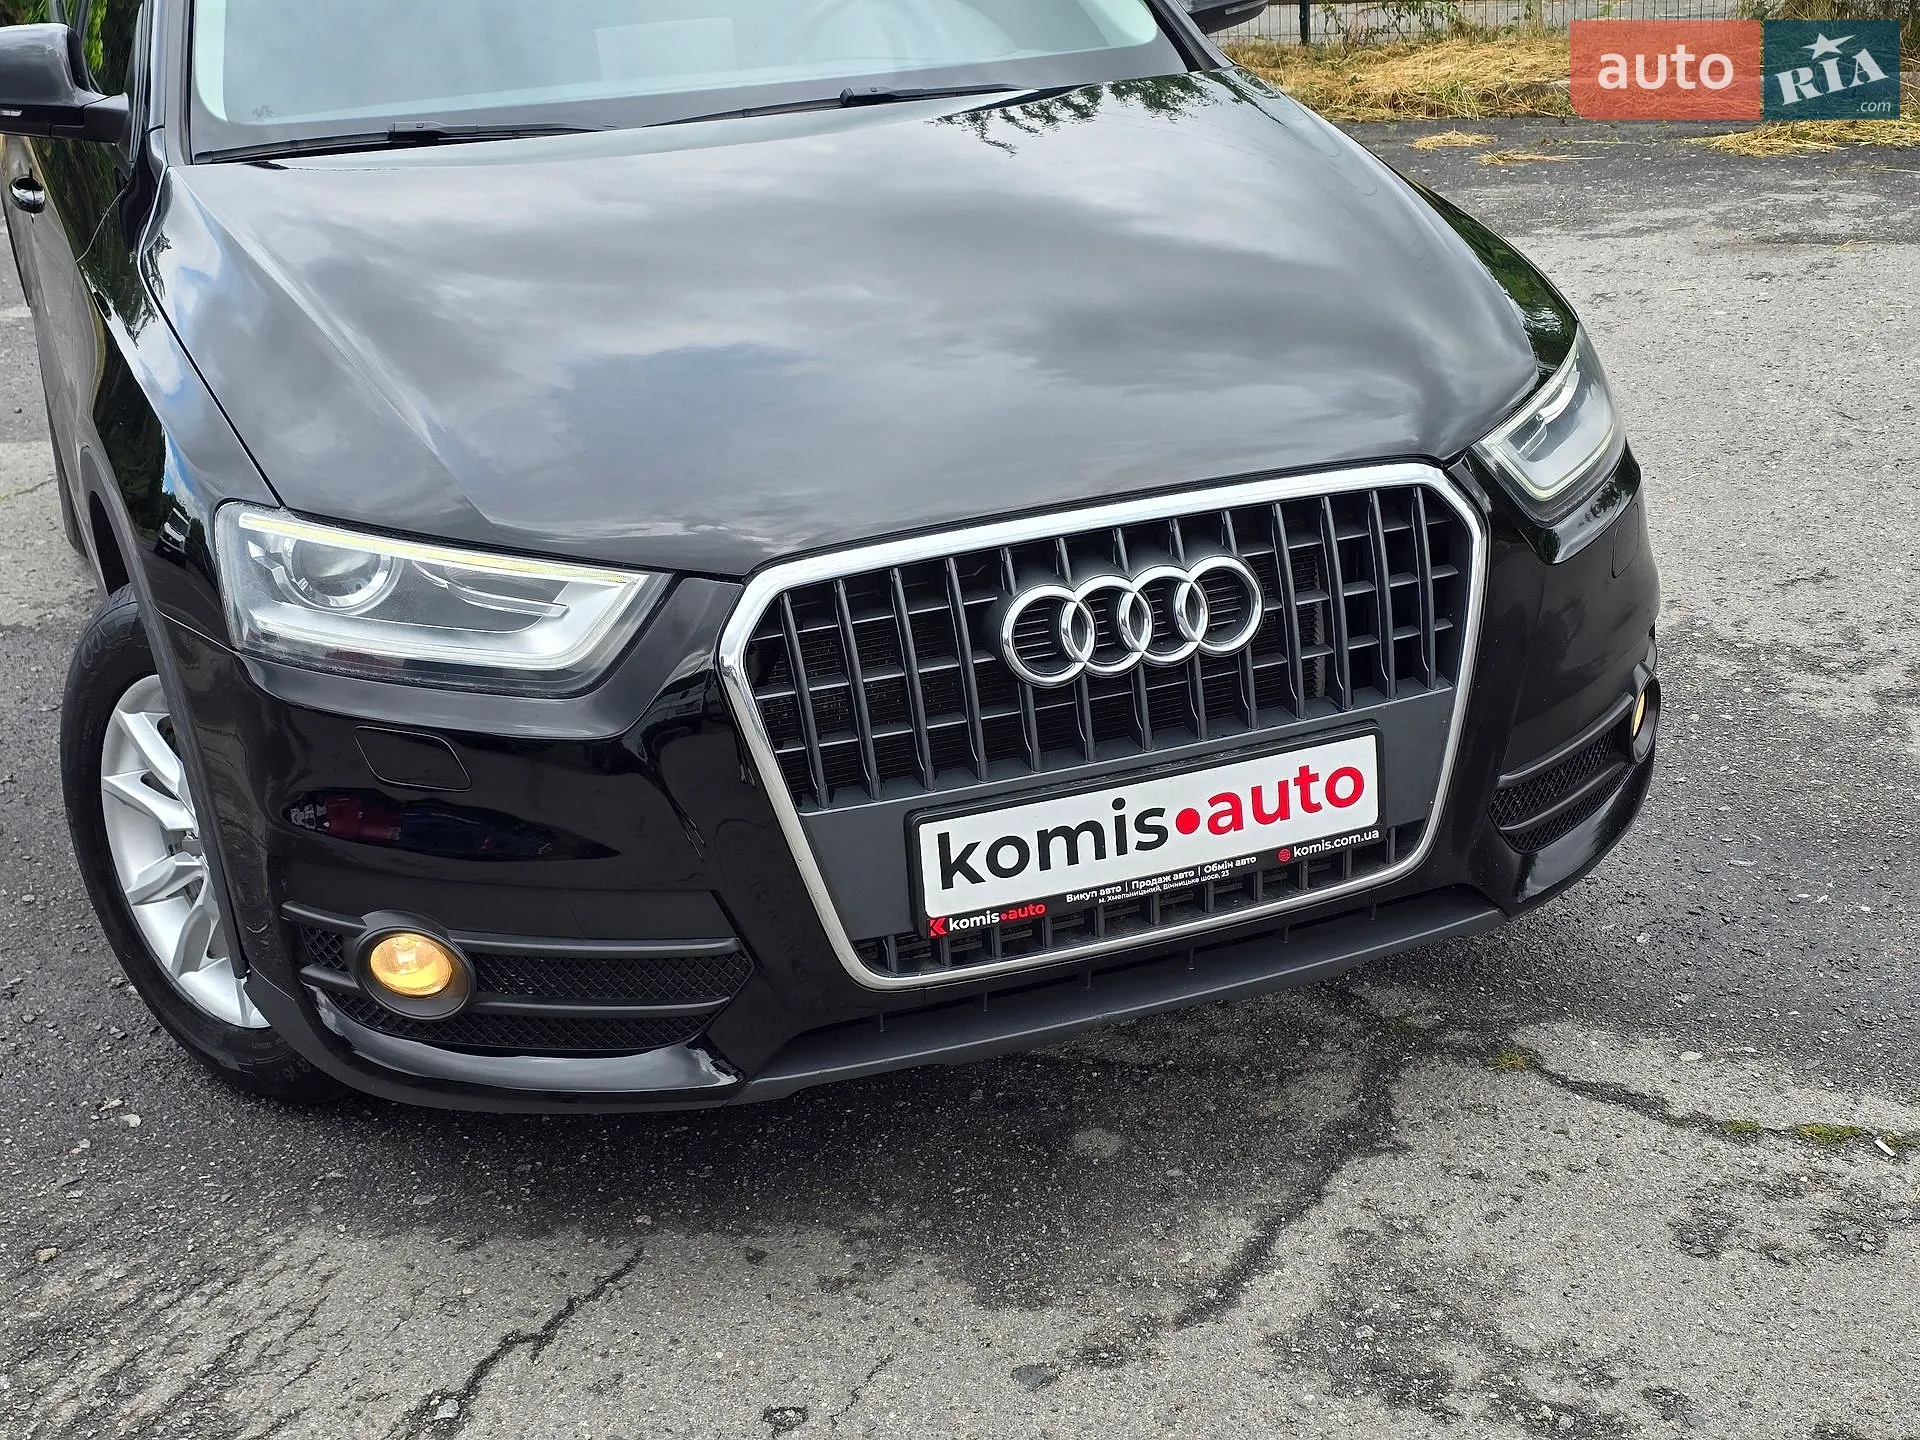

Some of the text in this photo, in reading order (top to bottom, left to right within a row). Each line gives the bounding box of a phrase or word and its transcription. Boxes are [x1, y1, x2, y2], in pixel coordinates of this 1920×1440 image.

[1293, 829, 1380, 858] komis.com.ua
[1066, 856, 1257, 903] Викуп авто Продаж авто Обмін авто
[1221, 869, 1230, 878] 23
